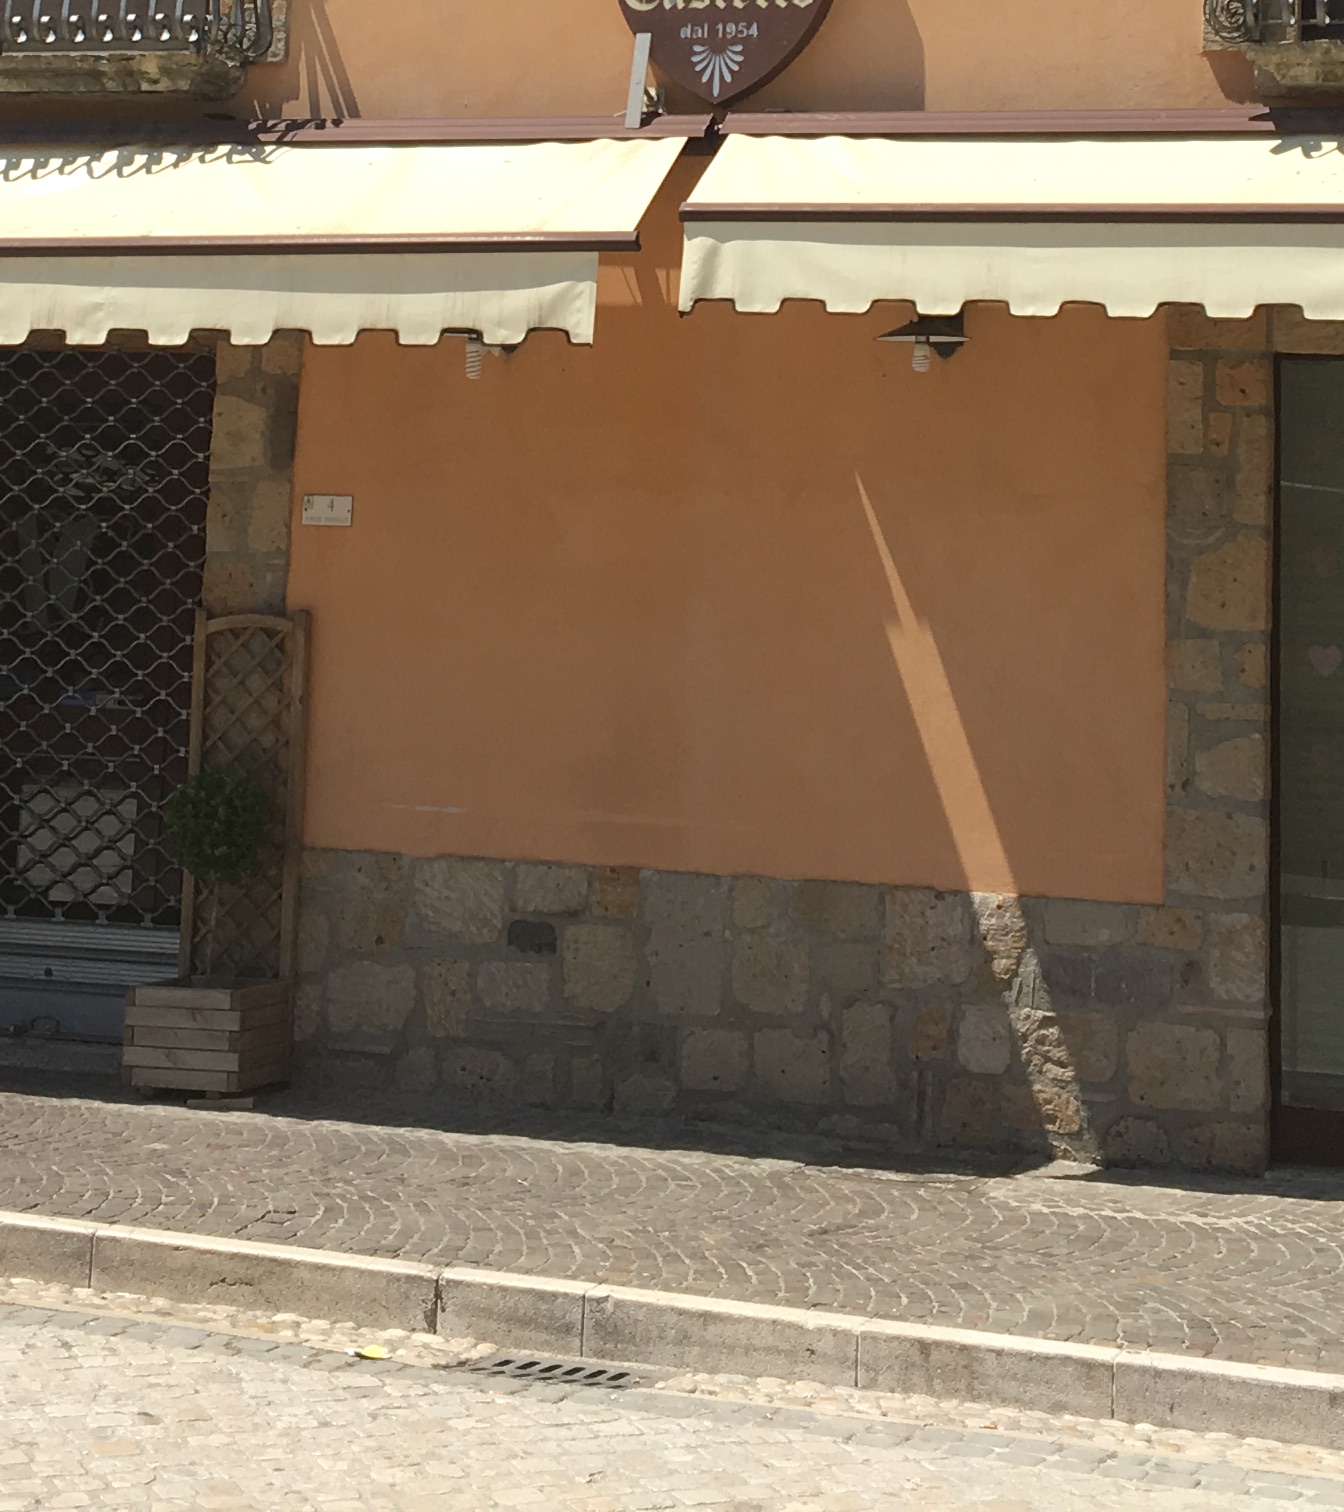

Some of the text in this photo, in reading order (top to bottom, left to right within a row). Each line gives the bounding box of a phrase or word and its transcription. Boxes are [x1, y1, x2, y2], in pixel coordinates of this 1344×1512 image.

[680, 22, 758, 38] dal 1954
[327, 498, 334, 512] 4
